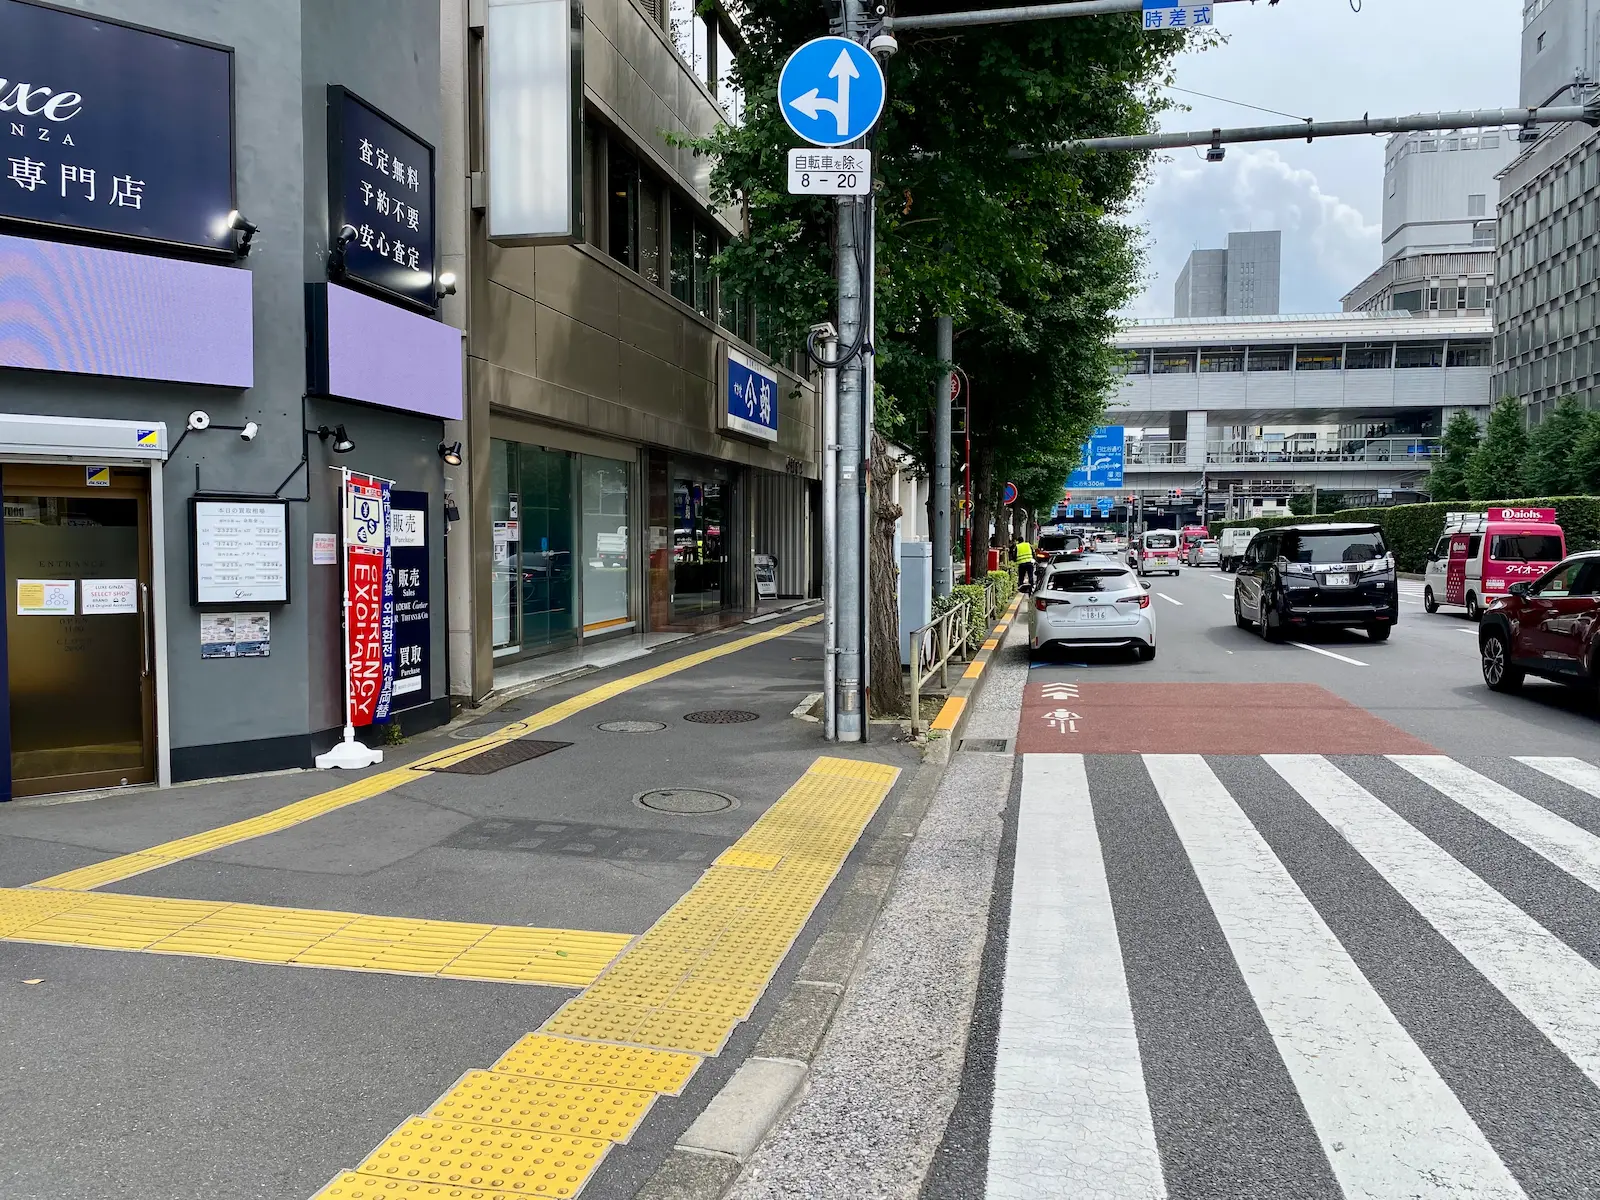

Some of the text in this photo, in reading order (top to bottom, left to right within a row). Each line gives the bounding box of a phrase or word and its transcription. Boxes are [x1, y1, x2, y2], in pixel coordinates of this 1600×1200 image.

[1145, 7, 1210, 28] 時差式
[359, 138, 420, 193] 査定無料
[795, 155, 863, 170] 自転車を除く
[7, 156, 146, 210] 専門店
[360, 180, 420, 232] 予約不要
[360, 224, 420, 271] 安心査定
[393, 514, 416, 533] 販売
[39, 560, 105, 568] ENTRANCE
[1506, 565, 1548, 575] ダイオーズ
[398, 568, 420, 588] 販売
[402, 588, 416, 598] Sales
[412, 599, 429, 611] Cartier
[358, 564, 380, 715] CURRENCY
[382, 601, 393, 658] 외화환전
[399, 645, 422, 667] 買取
[400, 667, 421, 677] Purchase
[376, 662, 394, 718] 外貨両替
